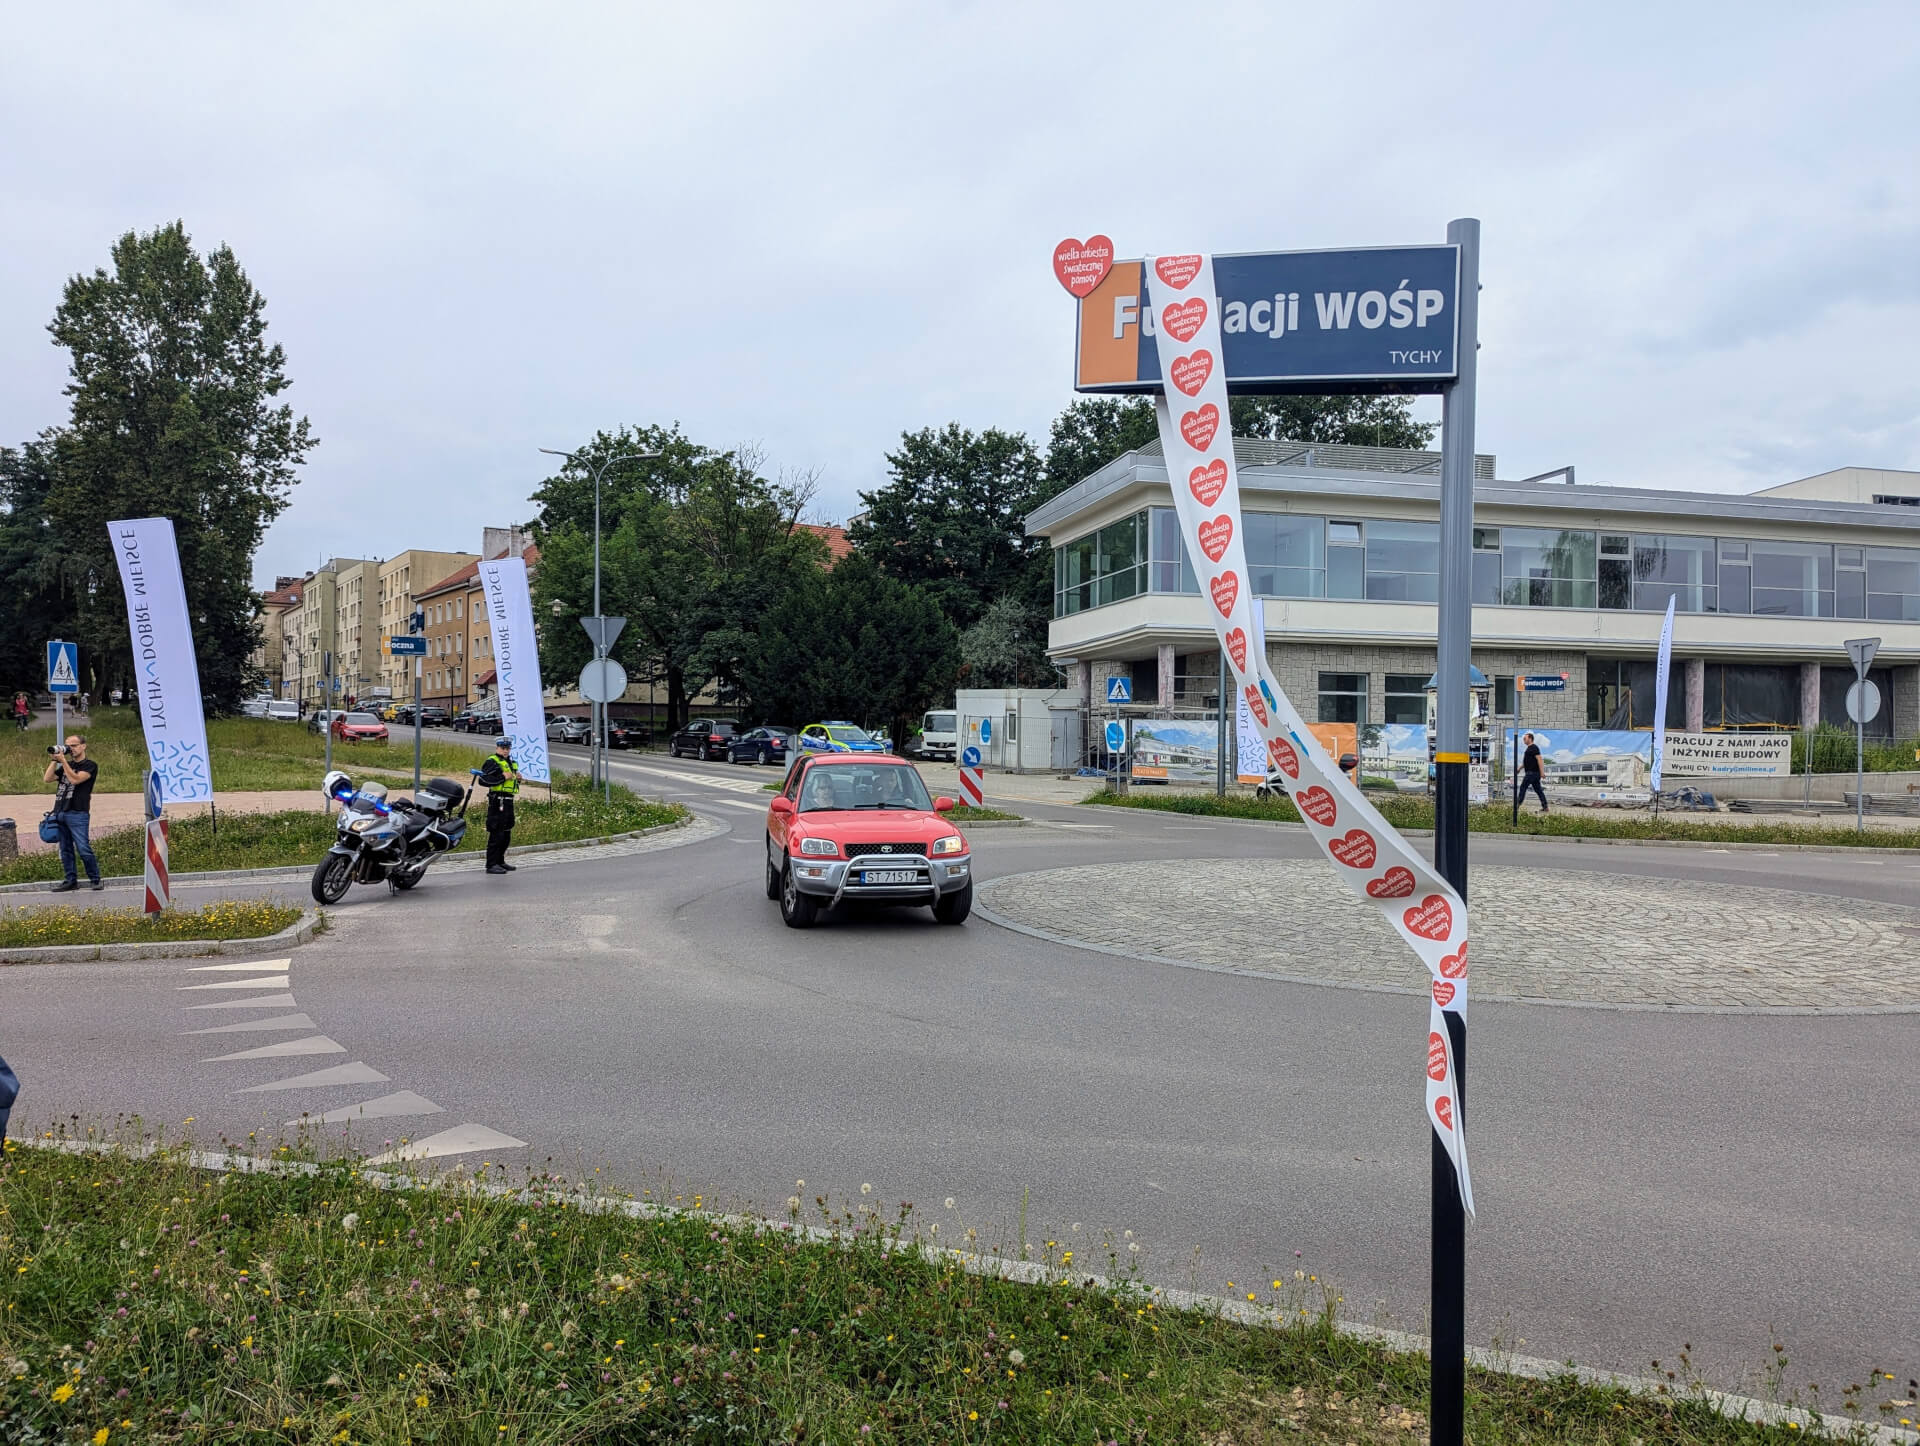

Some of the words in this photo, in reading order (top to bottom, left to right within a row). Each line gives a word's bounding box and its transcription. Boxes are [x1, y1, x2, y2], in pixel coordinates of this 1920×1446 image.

[1314, 279, 1444, 330] WOŚP
[1389, 350, 1443, 364] TYCHY
[1665, 736, 1713, 747] PRACUJ
[1717, 739, 1724, 747] Z
[1728, 739, 1756, 748] NAMI
[1760, 740, 1788, 748] JAKO
[1672, 747, 1730, 758] INŻYNIER
[1733, 750, 1781, 759] BUDOWY
[867, 872, 882, 882] ST
[884, 872, 916, 882] 71517
